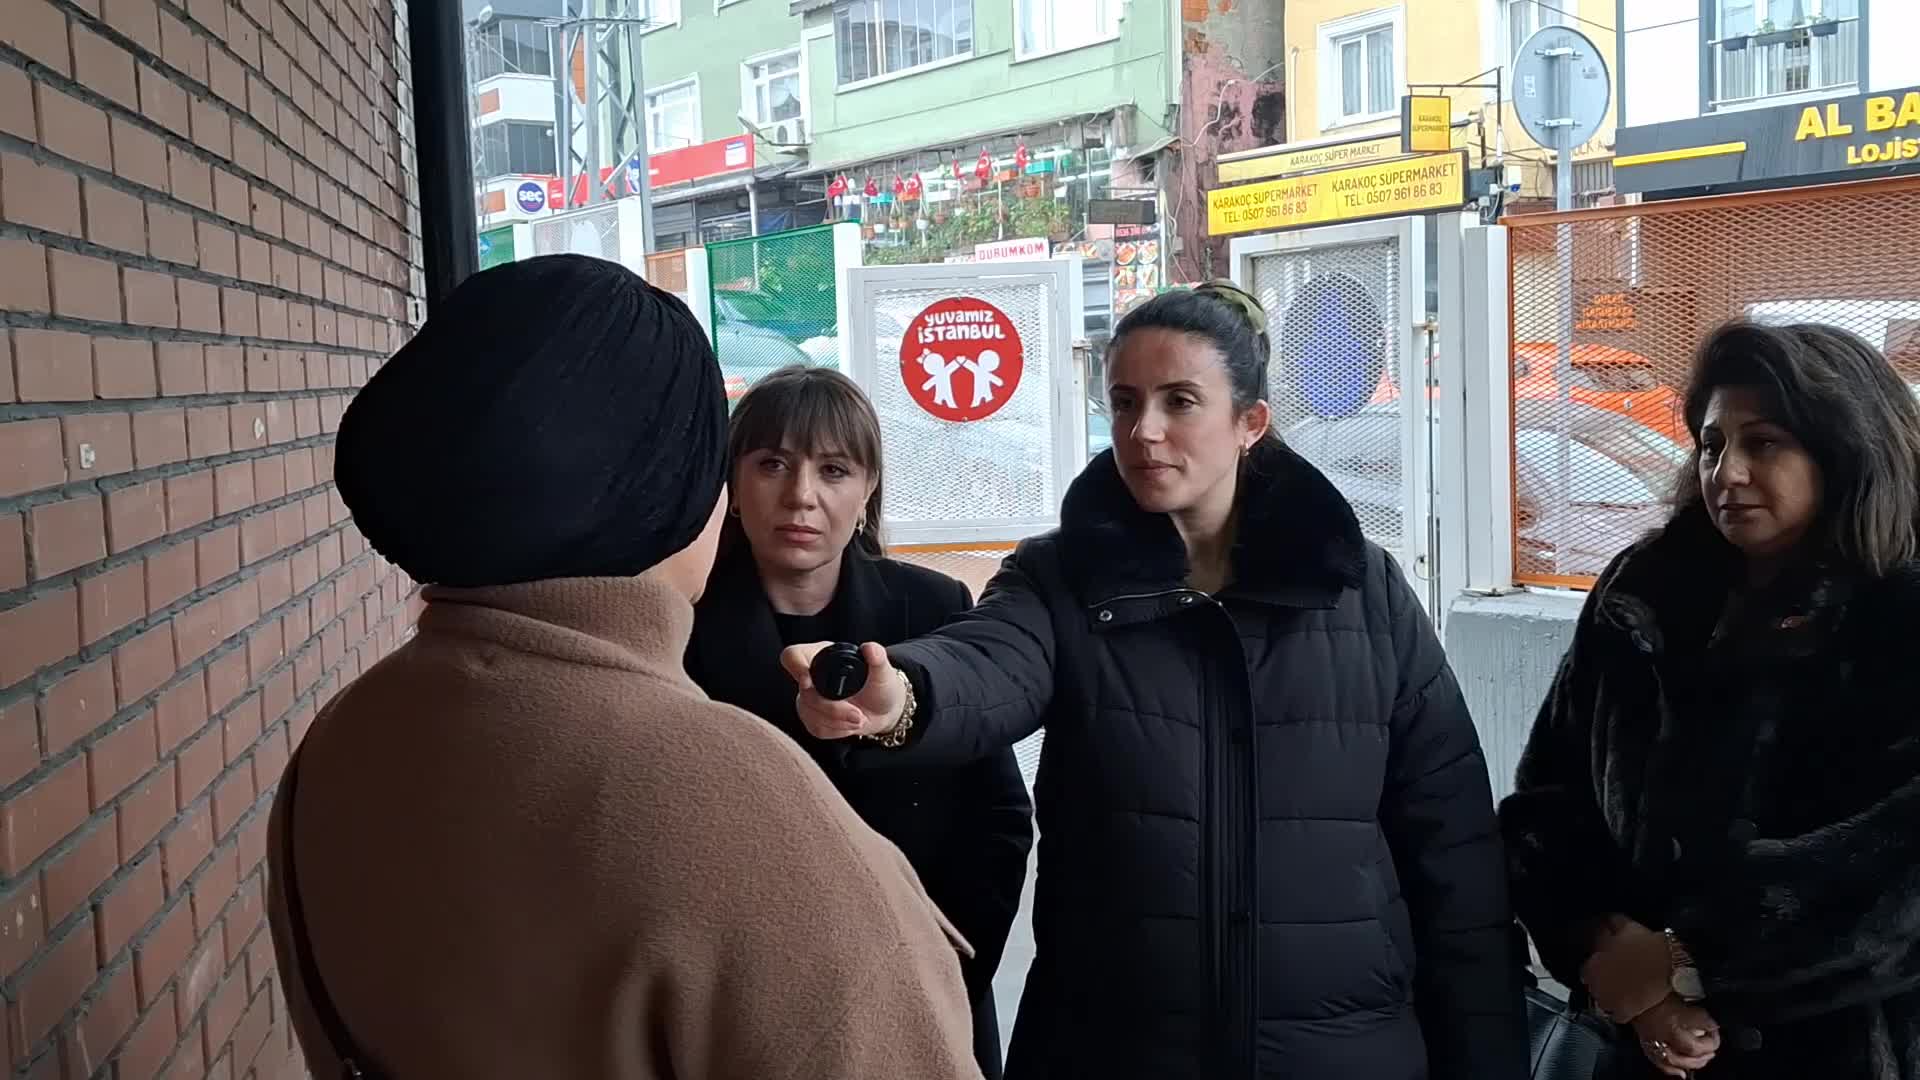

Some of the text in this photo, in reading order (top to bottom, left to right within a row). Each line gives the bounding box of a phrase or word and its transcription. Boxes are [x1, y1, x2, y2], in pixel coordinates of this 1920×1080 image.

[1795, 103, 1853, 141] AL
[1290, 152, 1323, 167] KARAKOÇ
[1349, 144, 1381, 157] MARKET
[1847, 136, 1920, 165] LOJİS
[1332, 174, 1377, 192] KARAKOÇ
[1366, 189, 1392, 205] 0507
[1394, 187, 1411, 201] 961
[1413, 184, 1428, 198] 86
[1429, 182, 1443, 196] 83
[1213, 193, 1252, 210] KARAKOÇ
[1242, 207, 1265, 221] 0507
[1265, 205, 1281, 218] 961
[1281, 203, 1294, 216] 86
[1295, 201, 1308, 214] 83
